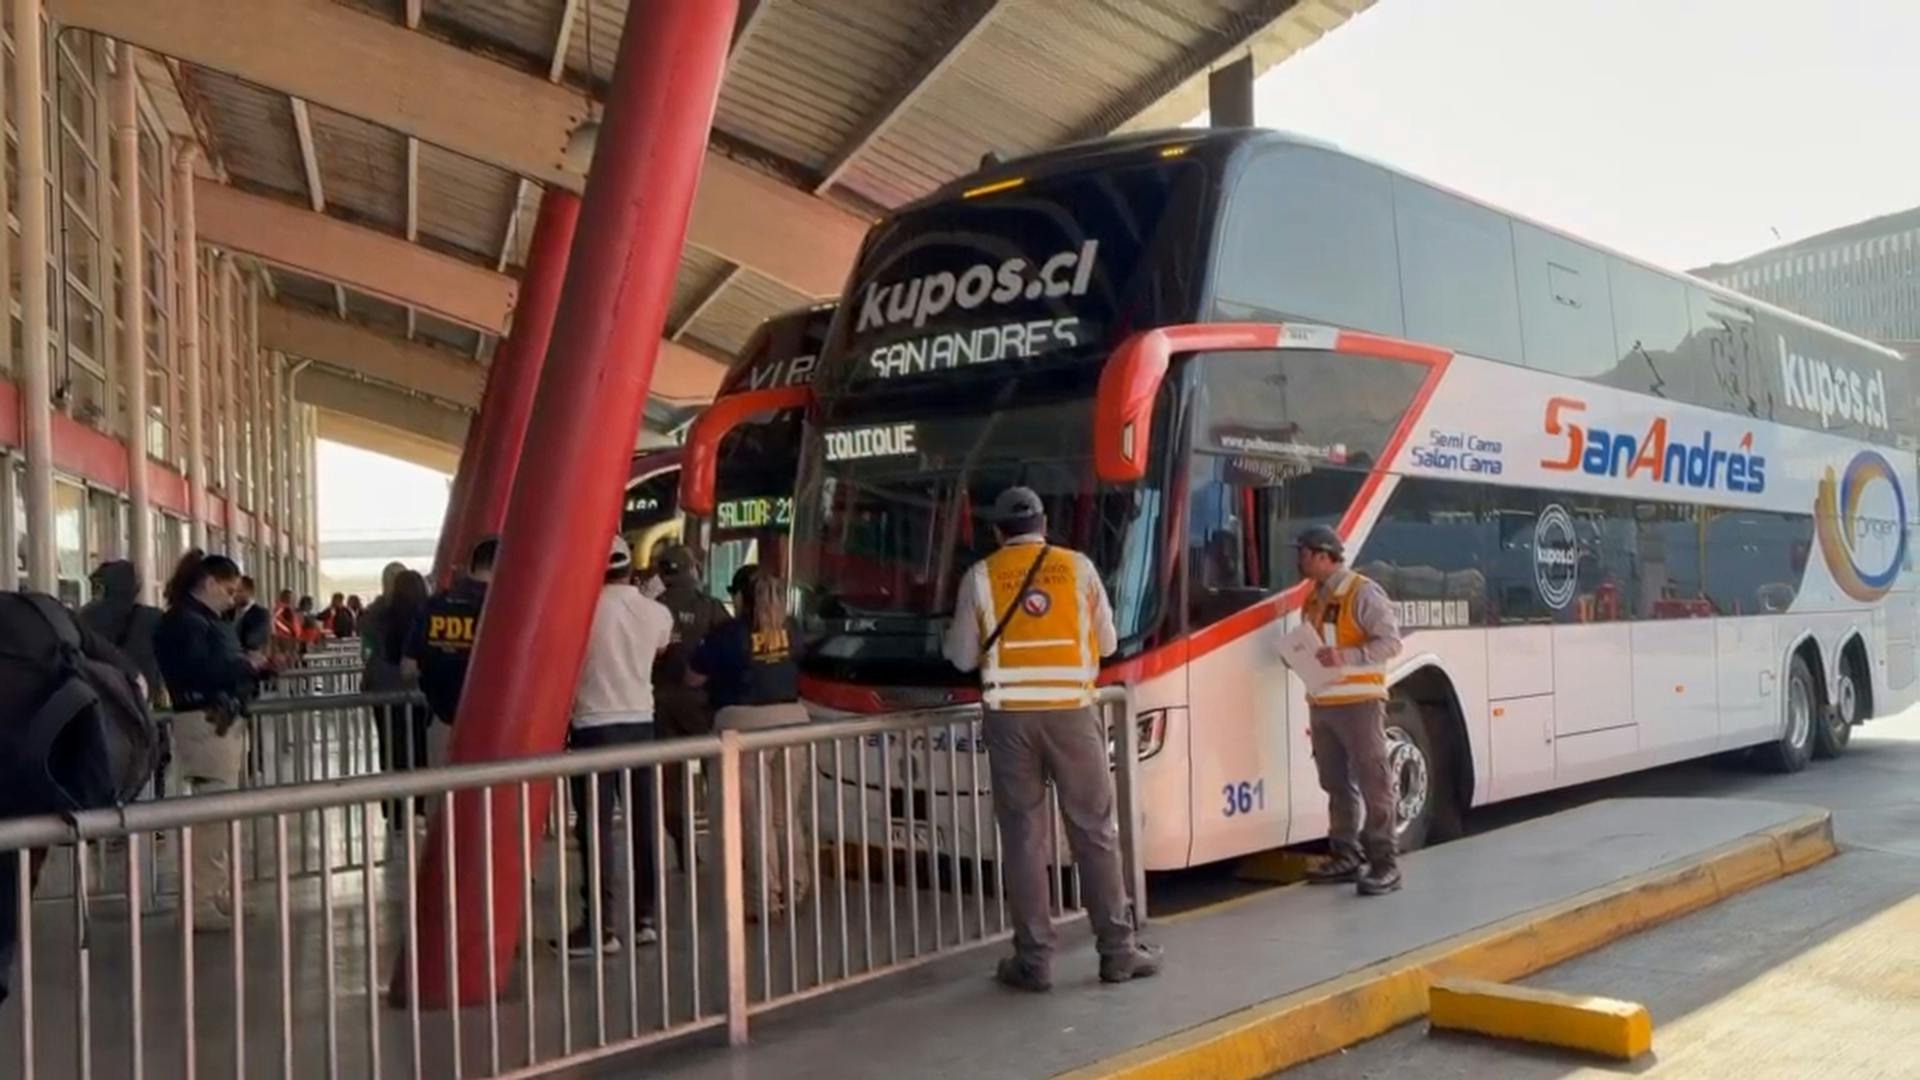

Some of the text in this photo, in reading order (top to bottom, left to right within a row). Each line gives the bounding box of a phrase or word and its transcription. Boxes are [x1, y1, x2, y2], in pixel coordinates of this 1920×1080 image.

[856, 239, 1098, 333] kupos.cl
[870, 338, 927, 378] SAN
[1778, 334, 1889, 431] kupos.cl
[824, 424, 916, 461] IQUIQUE
[1411, 446, 1503, 475] Salon Cama
[1429, 429, 1503, 454] Semi Cama
[428, 614, 475, 640] PDI
[1221, 778, 1265, 818] 361
